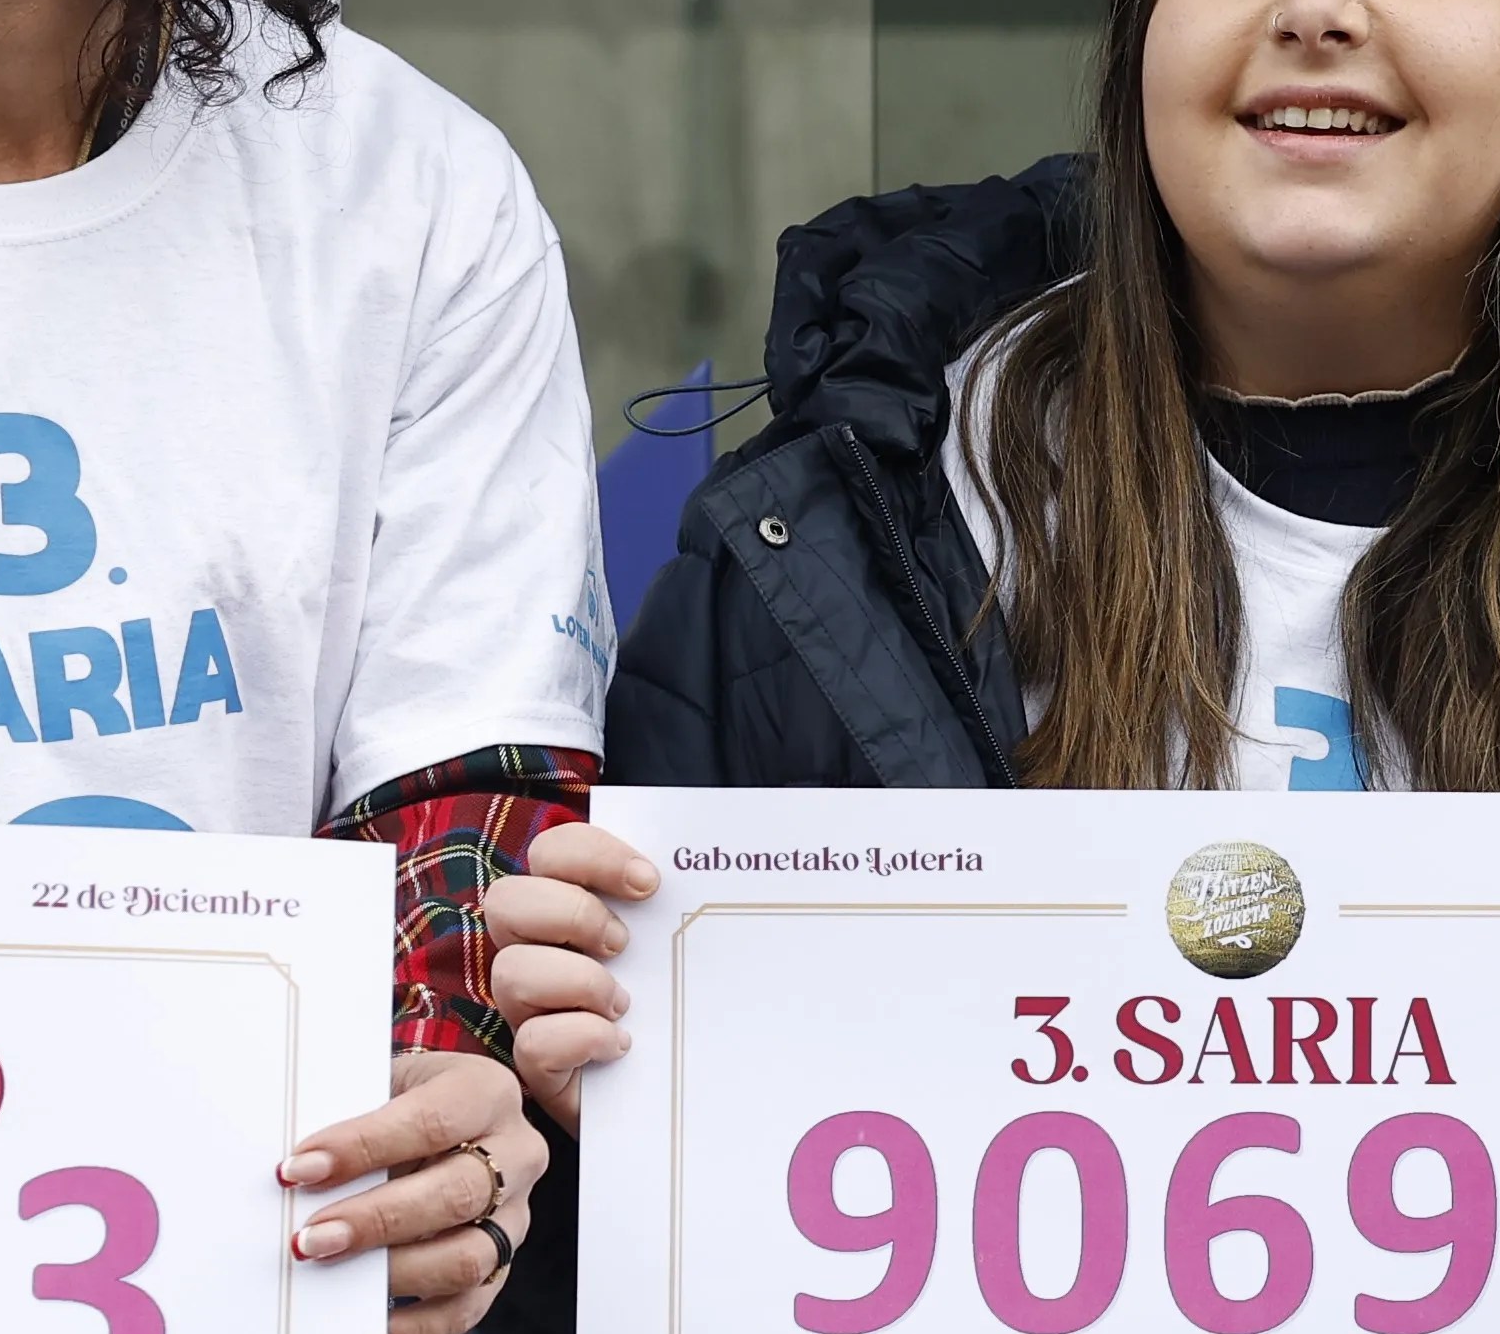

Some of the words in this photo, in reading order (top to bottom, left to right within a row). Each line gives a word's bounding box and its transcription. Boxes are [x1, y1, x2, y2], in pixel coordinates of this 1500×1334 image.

[673, 845, 860, 872] Gabonetako
[865, 846, 983, 877] Loteria
[32, 883, 69, 909] 22
[77, 883, 115, 910] de
[123, 885, 300, 918] Diciembre
[1203, 904, 1271, 939] ZOZKETA
[1011, 995, 1090, 1085] 3.
[1113, 995, 1458, 1086] SARIA
